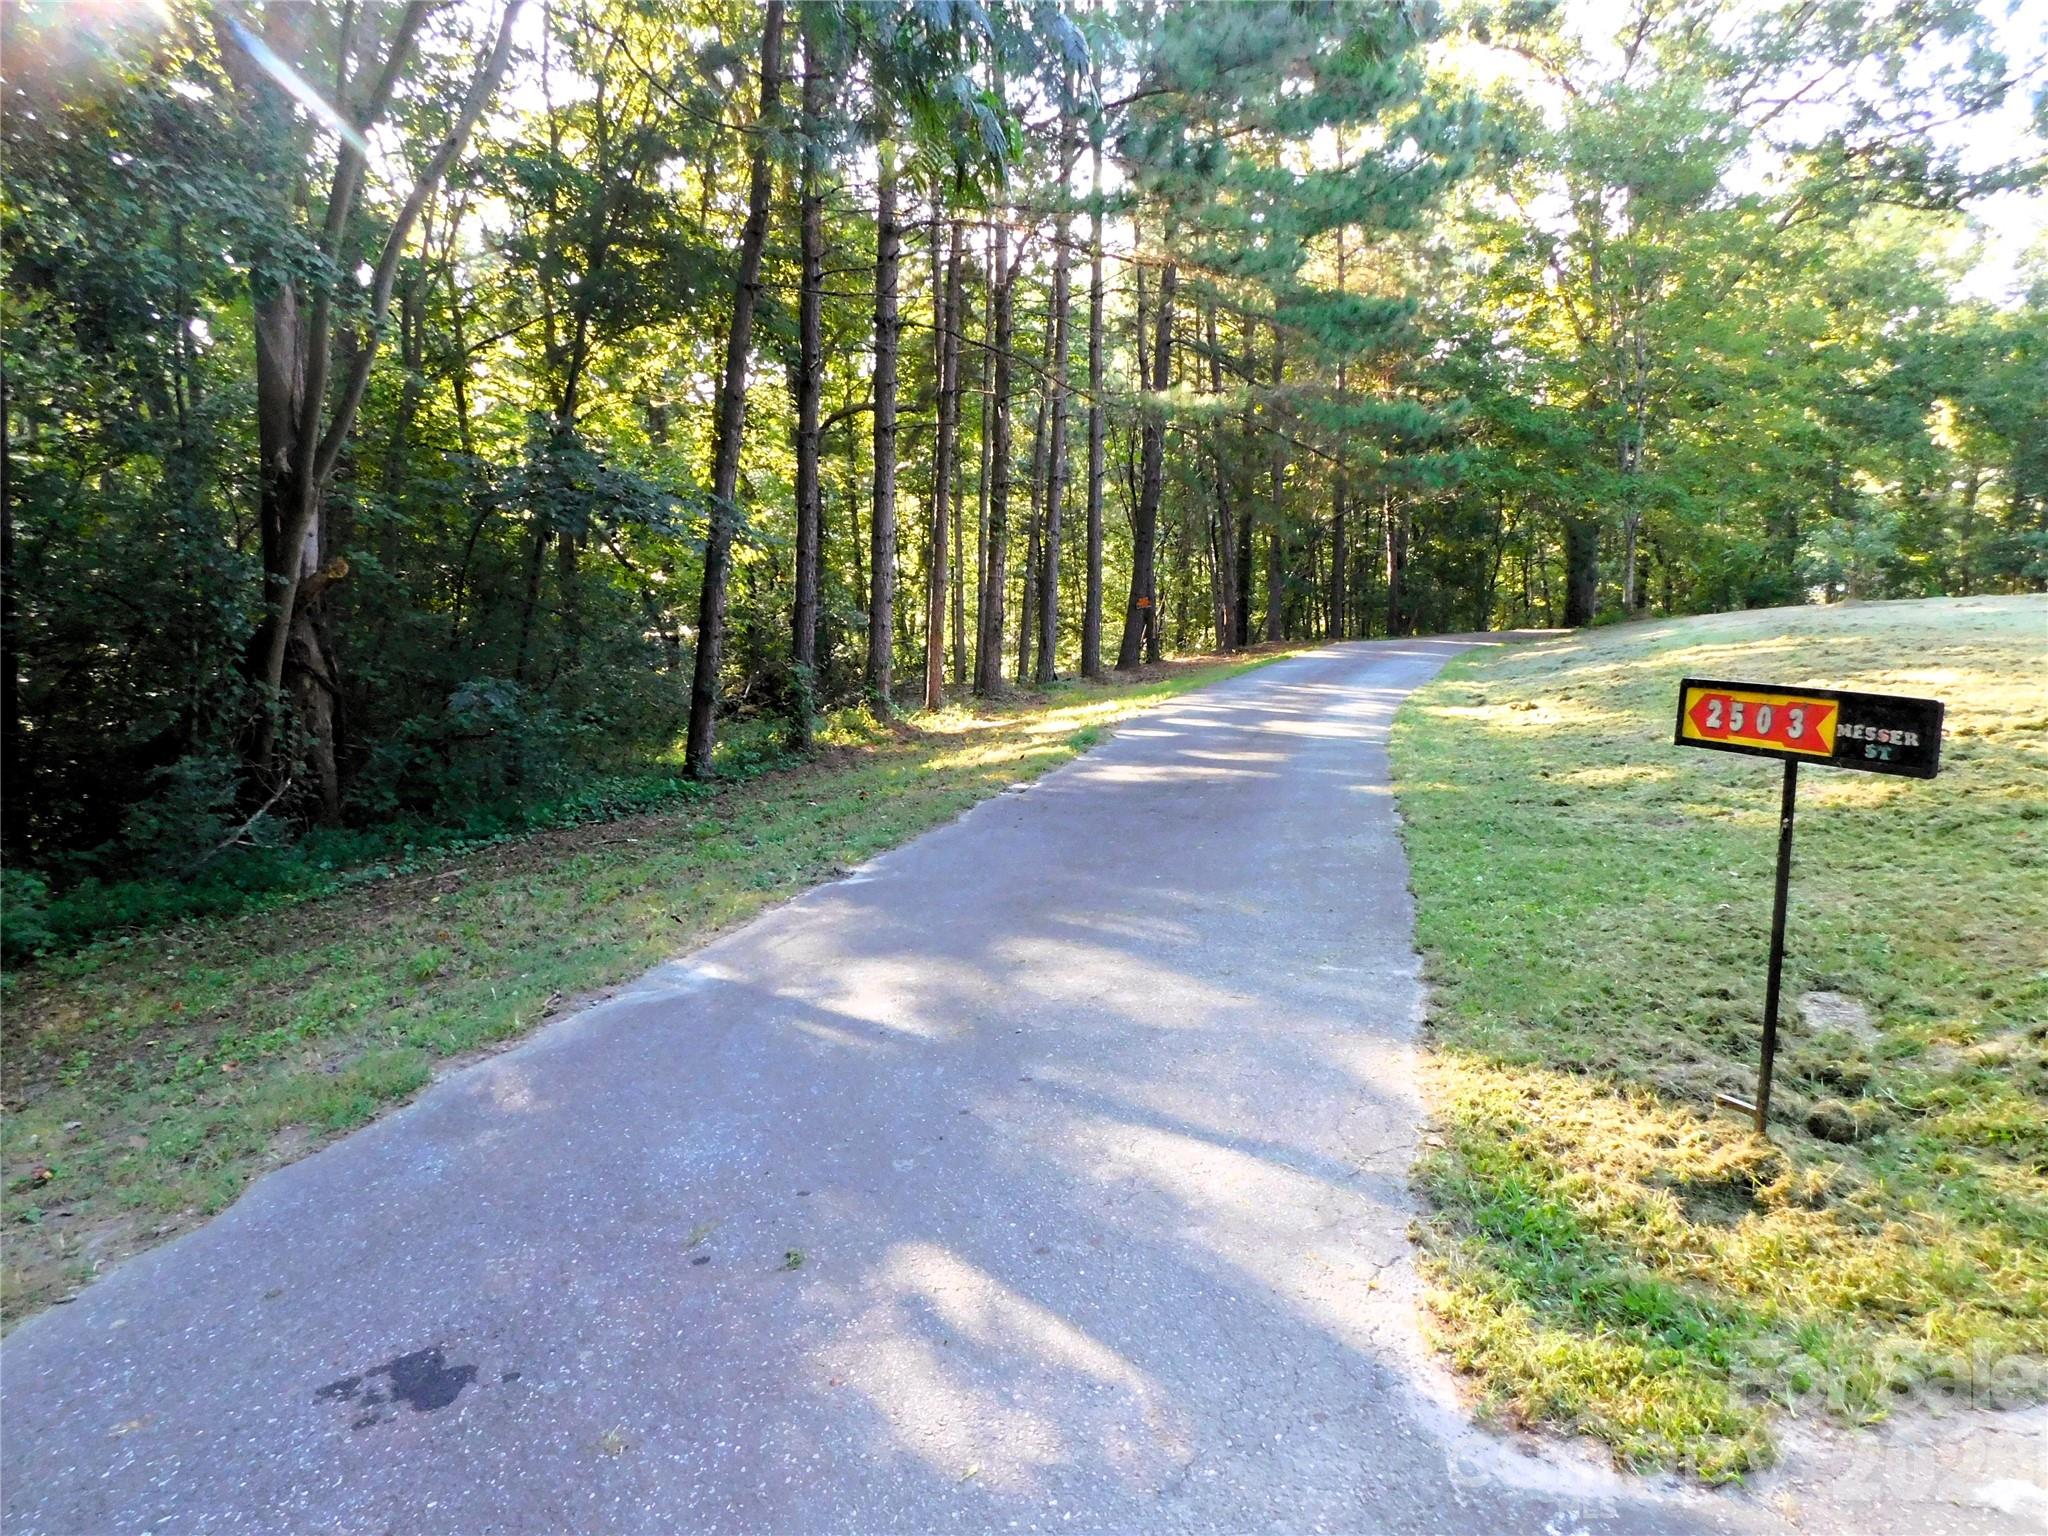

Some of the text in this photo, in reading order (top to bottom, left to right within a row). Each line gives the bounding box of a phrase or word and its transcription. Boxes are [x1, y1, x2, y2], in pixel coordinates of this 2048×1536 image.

[1705, 699, 1804, 739] 2503
[1837, 723, 1919, 747] MESSER
[1865, 743, 1892, 760] ST
